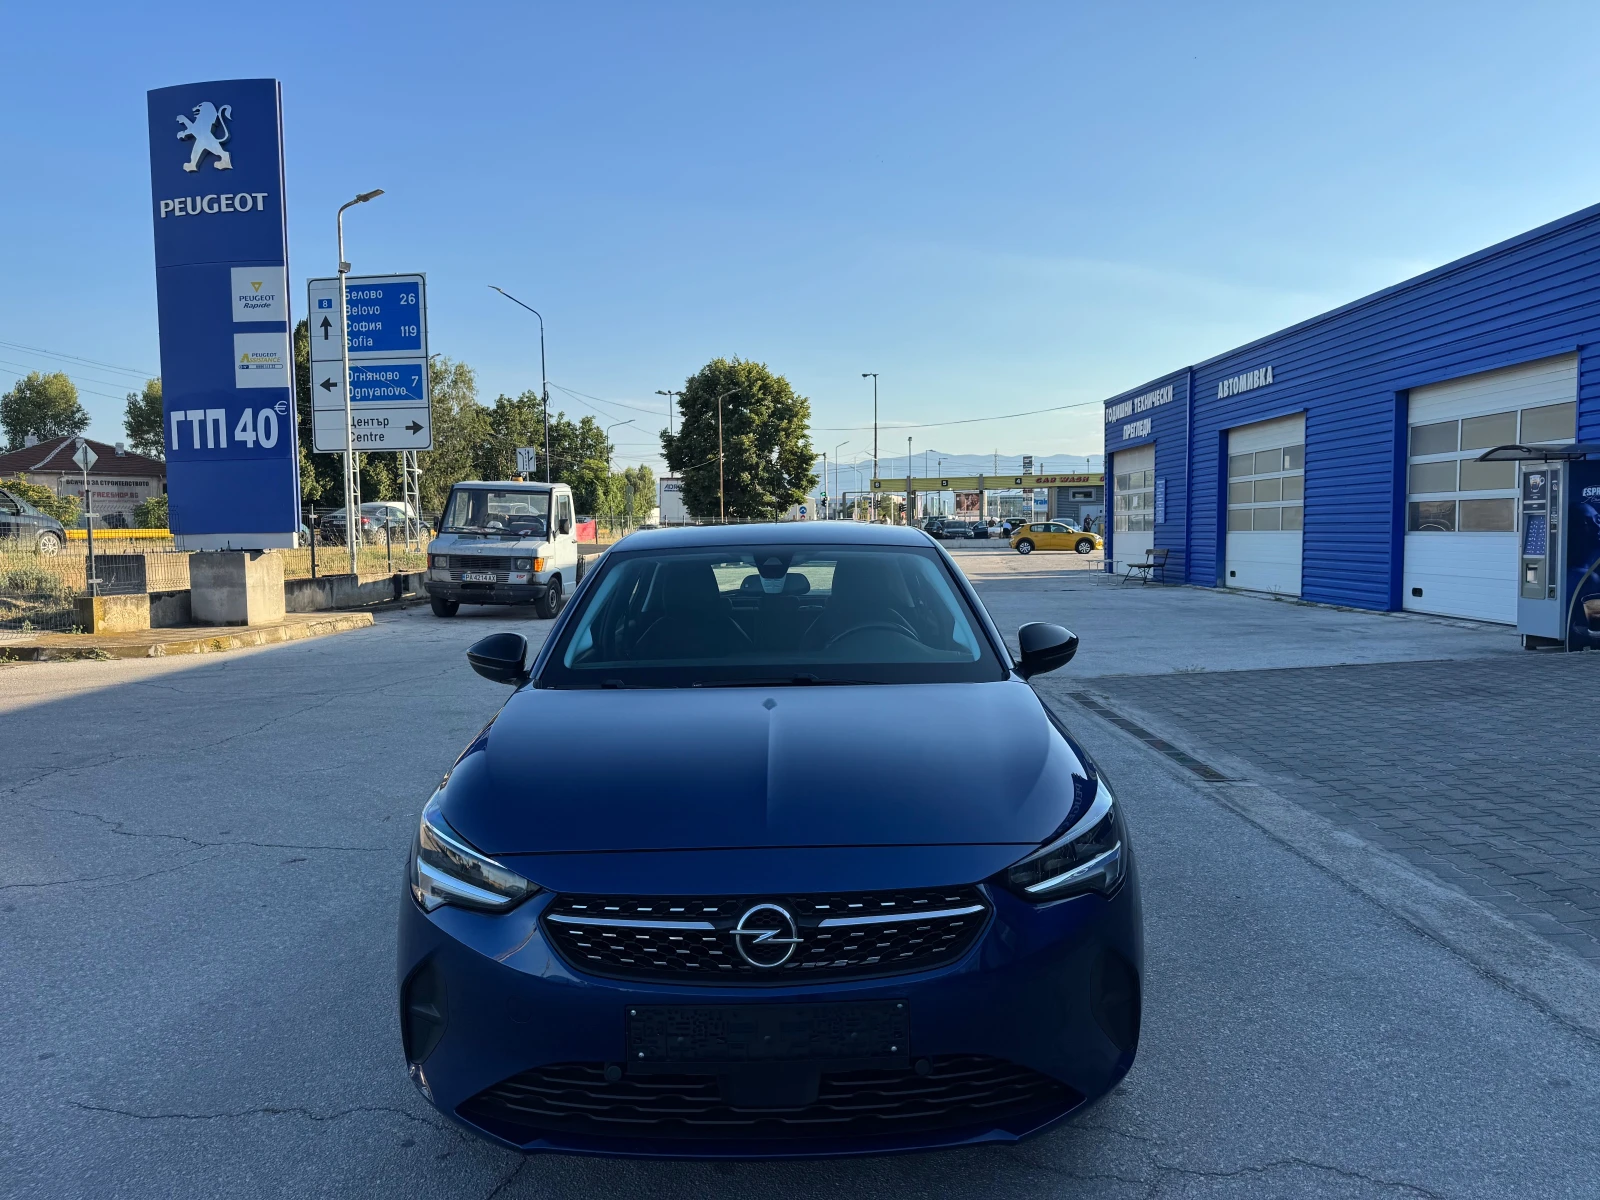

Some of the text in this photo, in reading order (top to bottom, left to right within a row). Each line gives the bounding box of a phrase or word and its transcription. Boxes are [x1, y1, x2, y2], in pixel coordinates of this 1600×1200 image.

[160, 192, 269, 218] PEUGEOT
[239, 294, 276, 302] PEUGEOT
[322, 299, 329, 308] 8
[400, 293, 416, 305] 26
[243, 302, 272, 310] Rapide
[345, 304, 381, 316] Belovo
[400, 325, 418, 337] 119
[411, 375, 419, 387] 7
[1217, 365, 1273, 400] АВТОМИВКА
[1105, 384, 1174, 424] ГОДИШНИ ТЕХНИЧЕСКИ
[170, 408, 228, 451] ГТП
[1123, 417, 1152, 441] ПРЕГЛЕДИ
